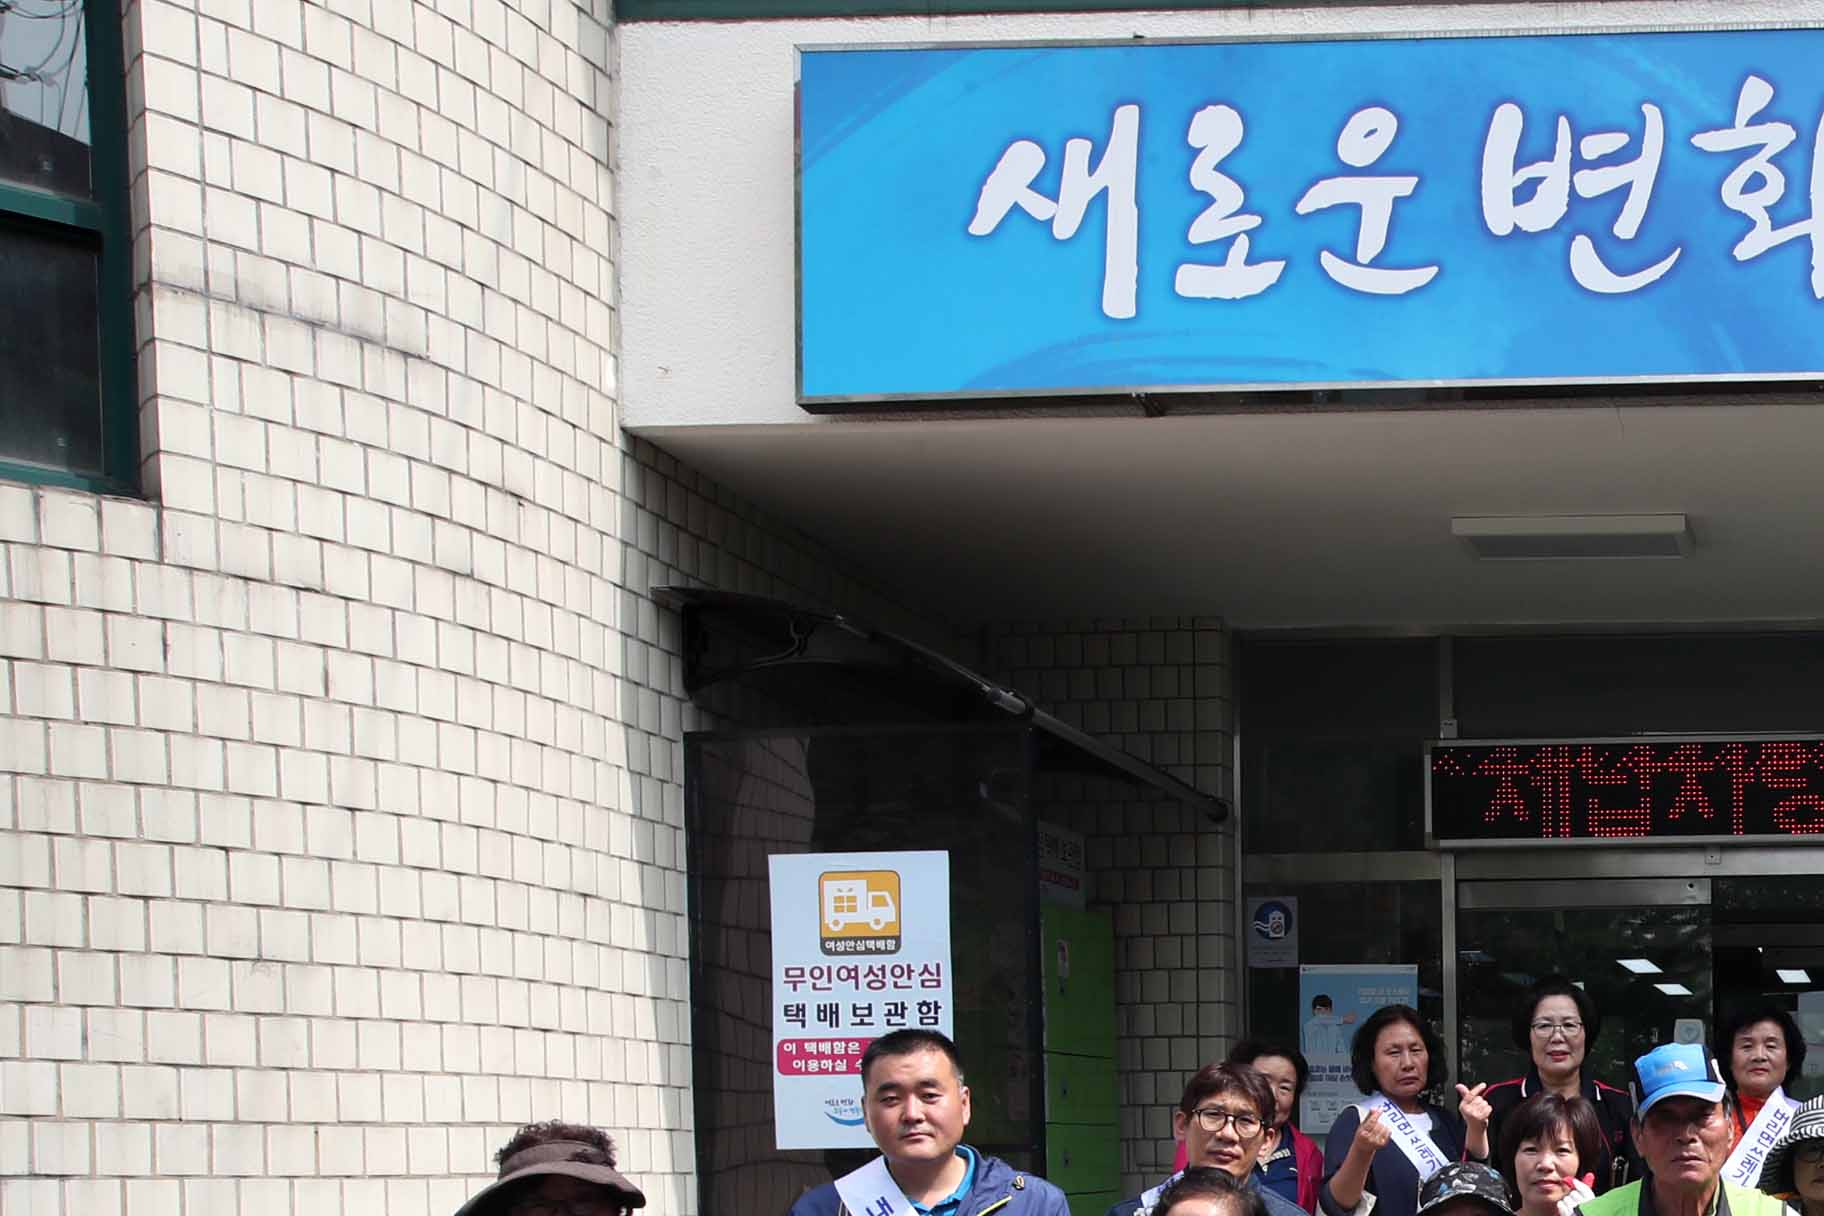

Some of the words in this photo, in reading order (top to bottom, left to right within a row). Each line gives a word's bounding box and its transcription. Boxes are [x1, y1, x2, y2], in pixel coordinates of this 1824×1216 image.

[967, 101, 1440, 320] 새로운
[824, 938, 896, 953] 여성안심택배함
[782, 962, 943, 992] 무인여성안심
[783, 1041, 797, 1055] 이
[803, 1040, 861, 1056] 택배함은
[792, 1058, 849, 1073] 이용하실
